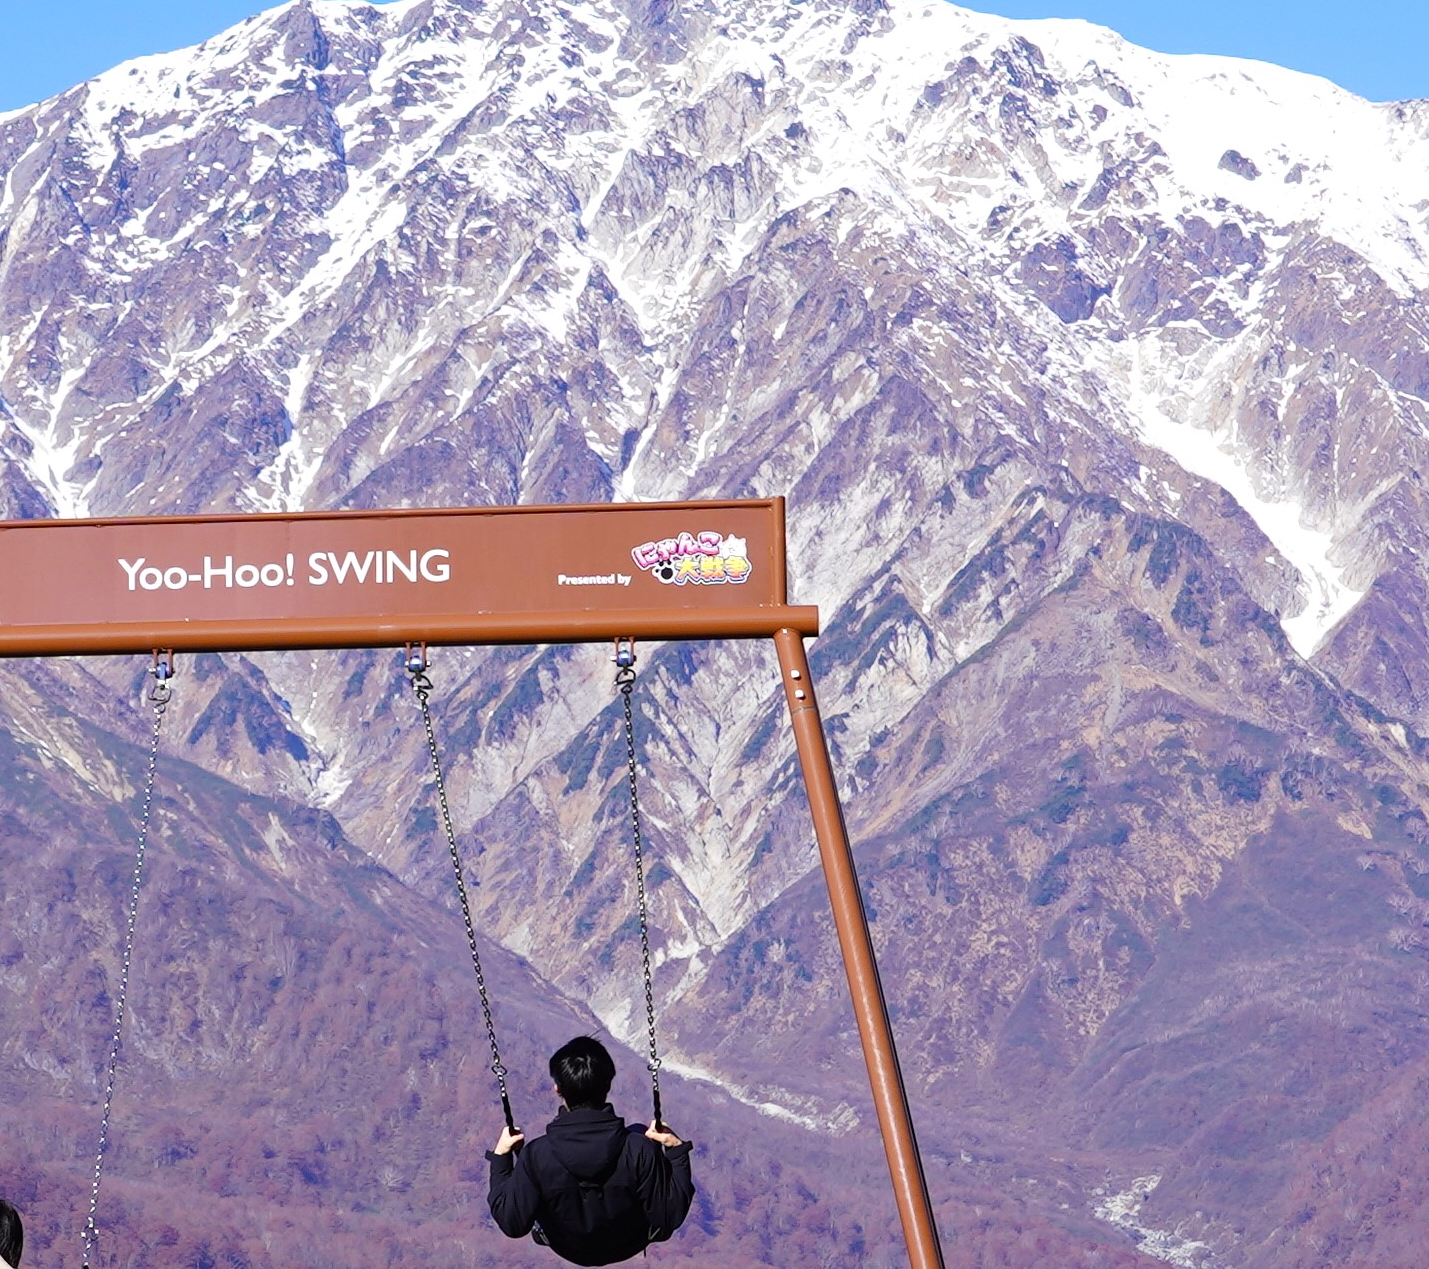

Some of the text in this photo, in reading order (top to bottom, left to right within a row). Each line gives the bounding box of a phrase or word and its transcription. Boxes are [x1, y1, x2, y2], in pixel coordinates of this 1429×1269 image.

[117, 549, 451, 591] Yoo-Hoo! SWING
[558, 573, 632, 587] Presented by
